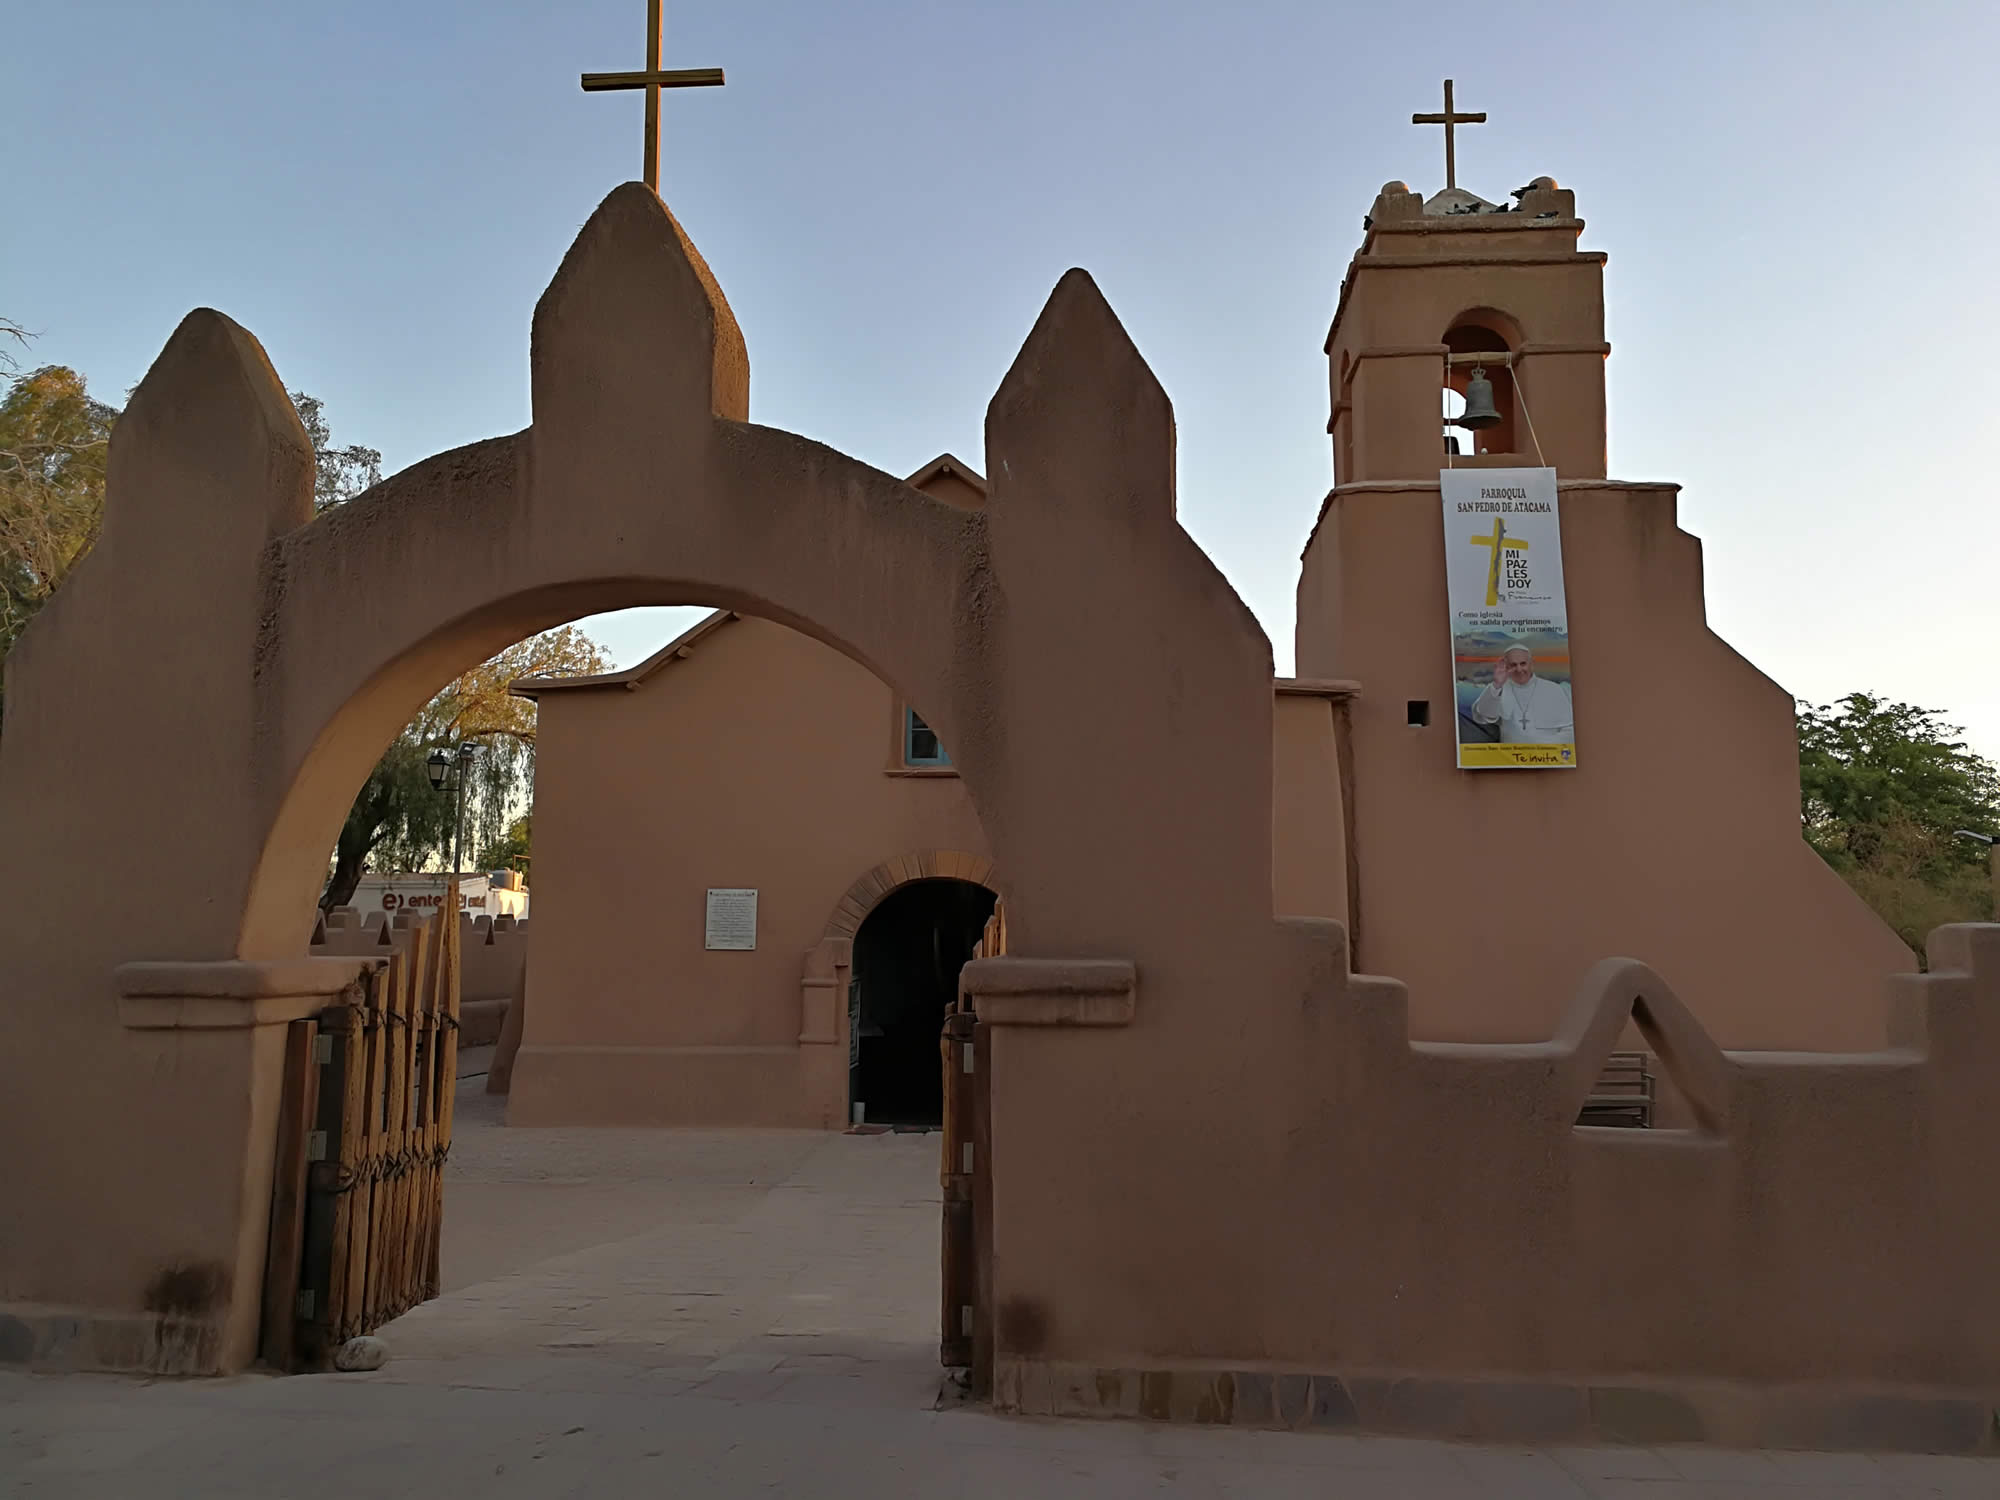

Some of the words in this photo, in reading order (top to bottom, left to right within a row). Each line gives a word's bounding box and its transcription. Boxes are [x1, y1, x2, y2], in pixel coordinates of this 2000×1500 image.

[1481, 487, 1527, 499] PARROQUIA
[1457, 502, 1474, 513] SAN
[1475, 502, 1501, 512] PEDRO
[1502, 502, 1512, 512] DE
[1513, 502, 1552, 512] ATACAMA
[1505, 549, 1519, 559] MI
[1506, 559, 1528, 569] PAZ
[1506, 569, 1528, 579] LES
[1507, 579, 1532, 589] DOY
[1512, 753, 1527, 762] Te
[1529, 752, 1559, 762] invita
[408, 894, 444, 907] ente
